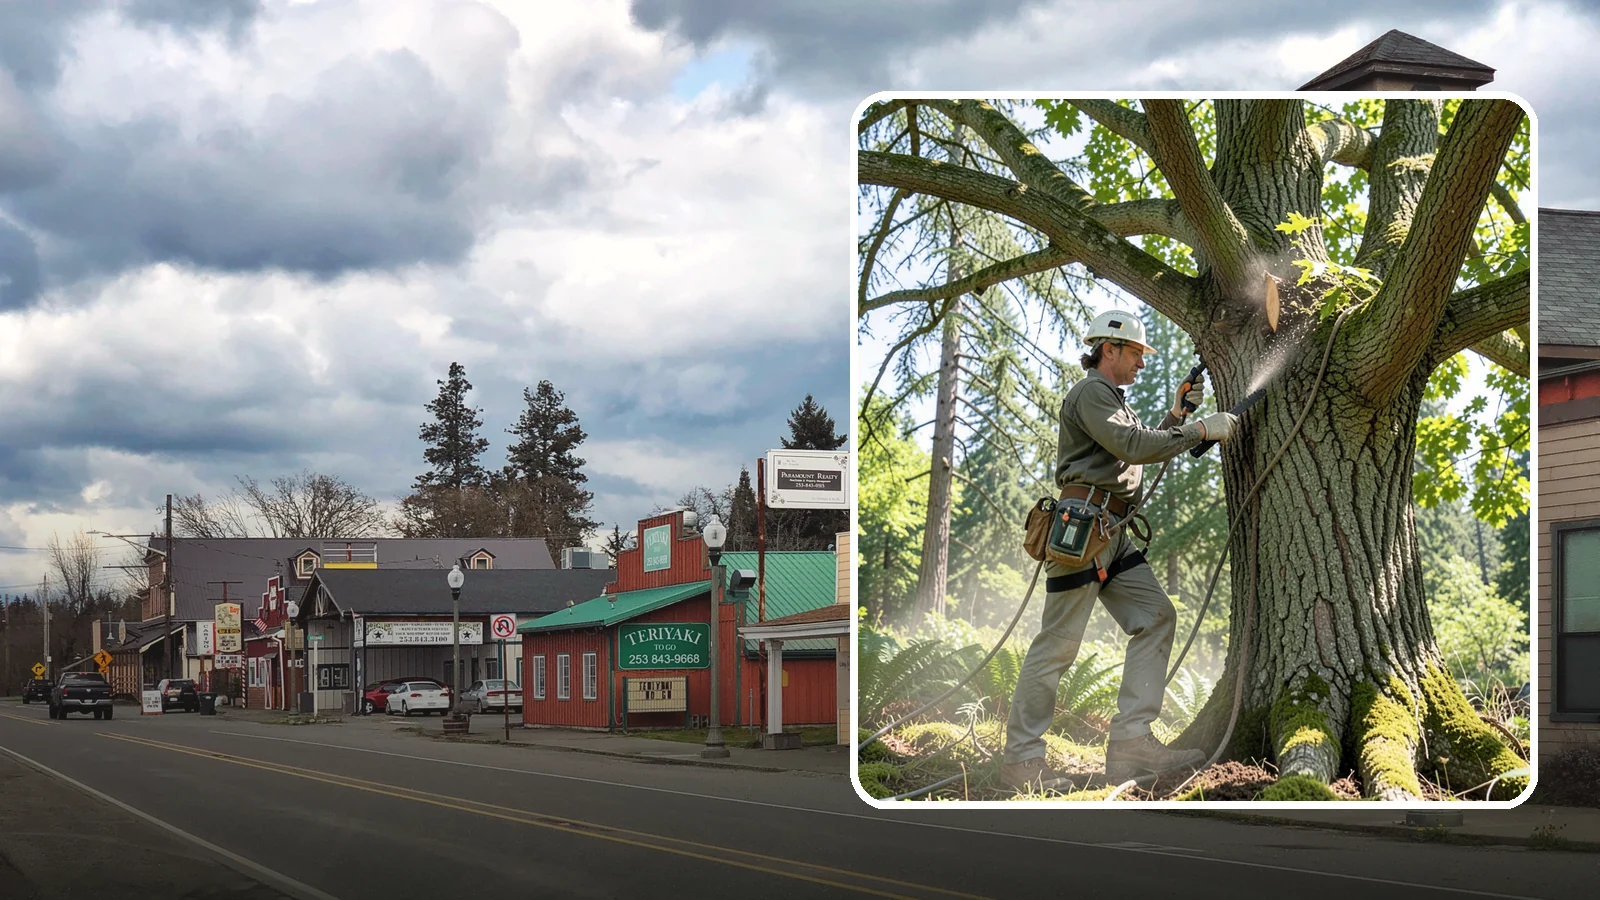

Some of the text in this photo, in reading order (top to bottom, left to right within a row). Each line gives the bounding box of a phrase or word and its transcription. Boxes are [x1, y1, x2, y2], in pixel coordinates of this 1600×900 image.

[781, 471, 839, 480] PARAMOUNT REALTY
[646, 530, 669, 549] TERIYAKI
[624, 627, 702, 646] TERIYAKI
[653, 643, 677, 651] TO GO
[628, 653, 700, 665] 253 843-9668
[639, 681, 673, 691] TERIYAKI
